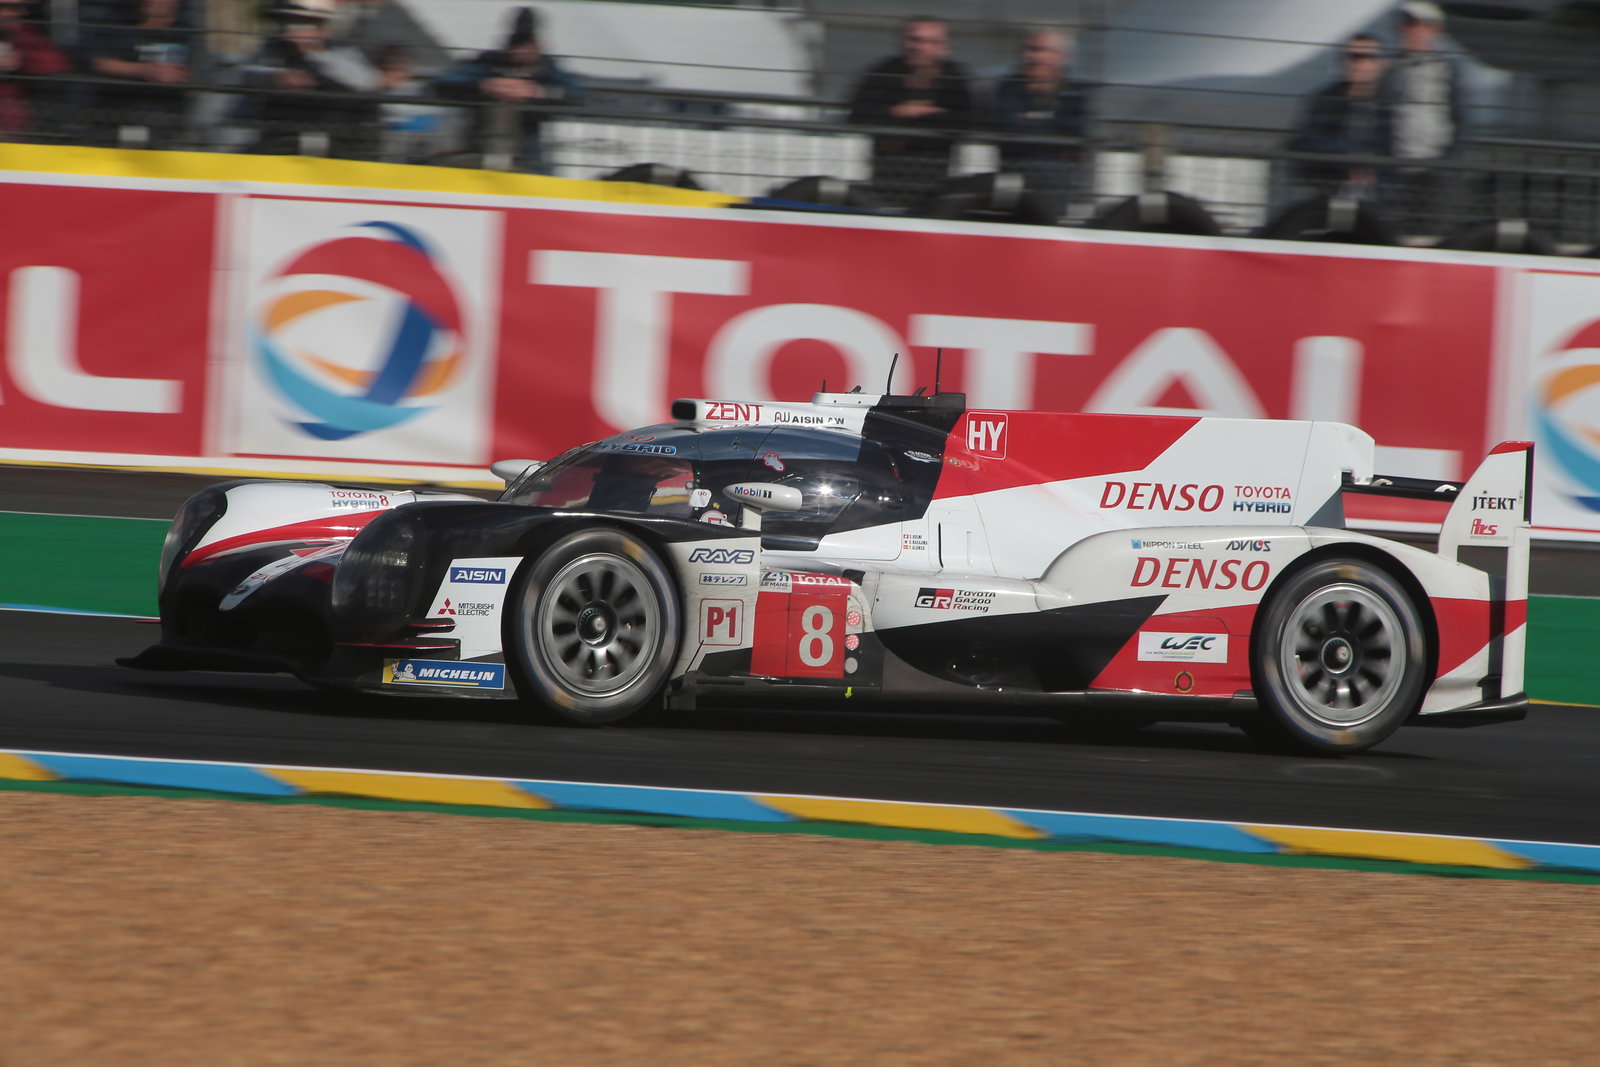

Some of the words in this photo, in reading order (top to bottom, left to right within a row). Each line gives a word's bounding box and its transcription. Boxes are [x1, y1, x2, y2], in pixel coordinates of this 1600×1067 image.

[527, 249, 1464, 482] TOTAL
[704, 401, 765, 422] ZENT
[792, 416, 824, 425] AISIN
[968, 420, 1005, 452] HY
[329, 490, 377, 500] TOYOTA
[735, 486, 762, 498] Mobil
[1099, 481, 1225, 513] DENSO
[1234, 485, 1291, 499] TOYOTA
[332, 500, 380, 510] HYBRID
[379, 494, 390, 507] 8
[1233, 500, 1292, 514] HYBRID
[1471, 496, 1517, 511] JTEKT
[1143, 541, 1175, 549] NIPPON
[1176, 541, 1204, 550] STEEL
[1225, 540, 1271, 552] ADVICS
[689, 548, 755, 564] RAYS
[454, 570, 503, 581] AISIN
[793, 574, 844, 586] TOTAL
[1130, 556, 1270, 591] DENSO
[957, 589, 996, 598] TOYOTA
[915, 595, 952, 609] GR
[955, 597, 992, 605] GAZOO
[953, 603, 989, 613] Racing
[706, 606, 737, 638] P1
[799, 605, 834, 667] 8
[1160, 635, 1217, 651] WEC
[418, 668, 496, 681] MICHELIN
